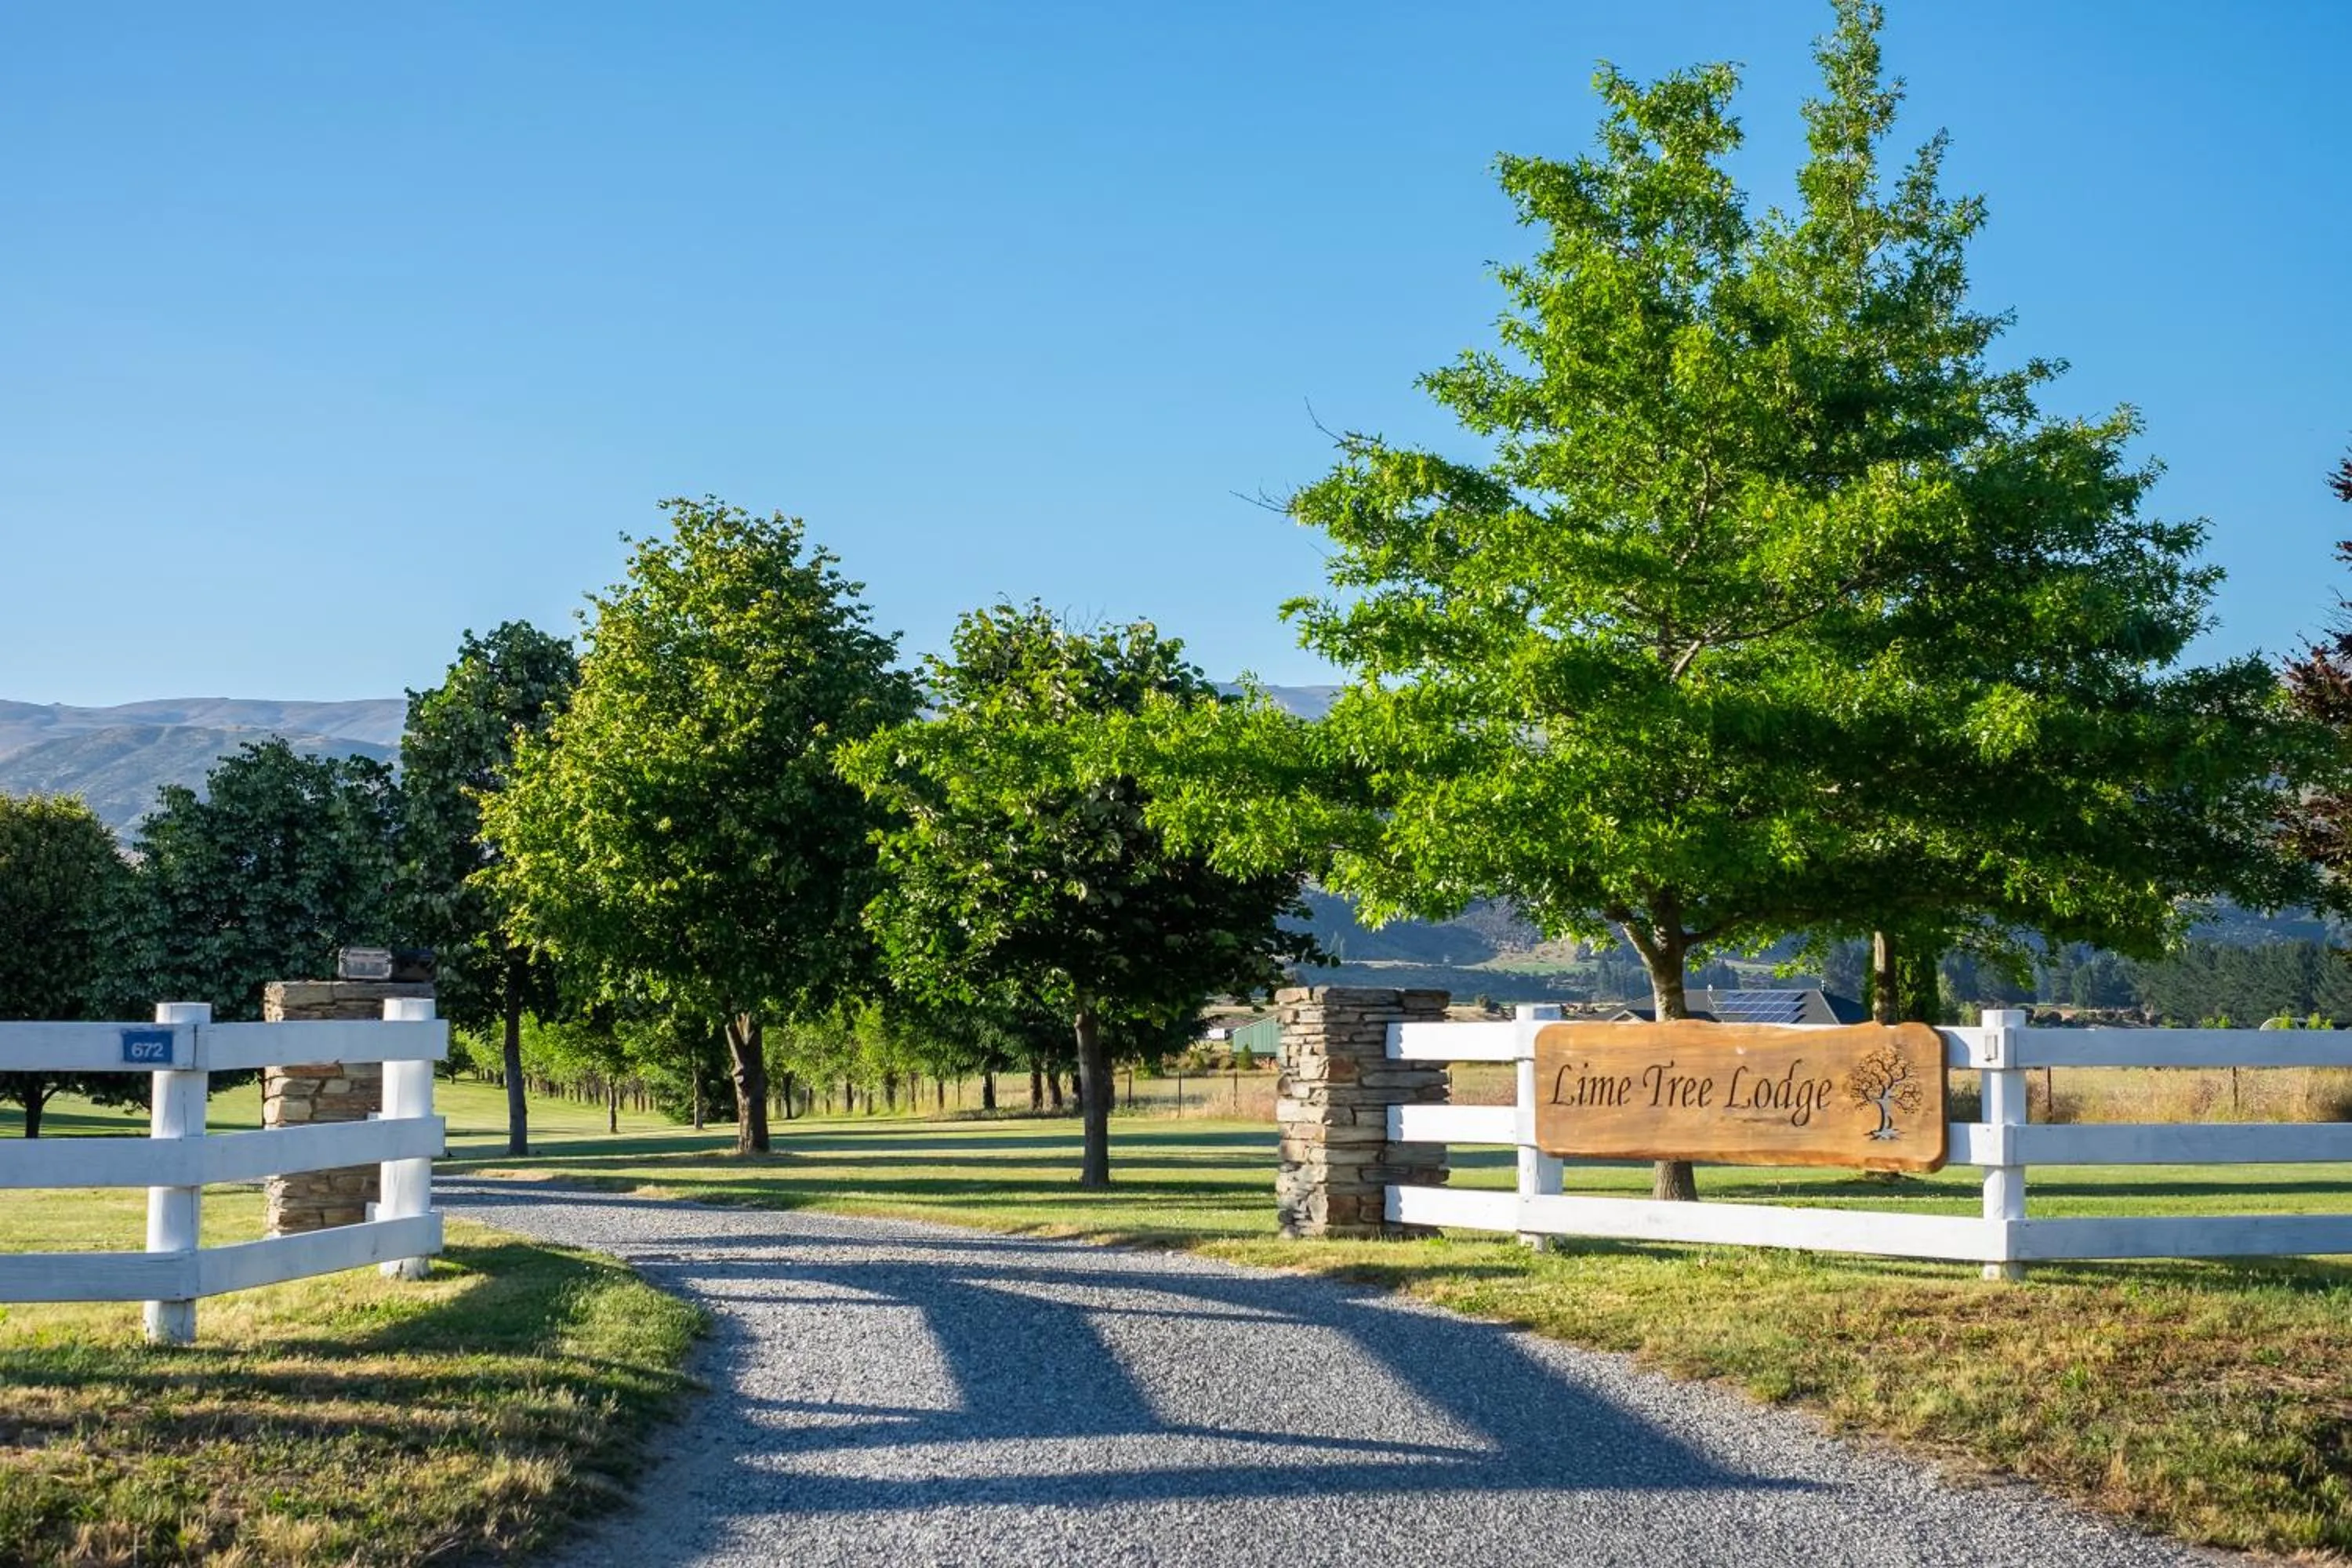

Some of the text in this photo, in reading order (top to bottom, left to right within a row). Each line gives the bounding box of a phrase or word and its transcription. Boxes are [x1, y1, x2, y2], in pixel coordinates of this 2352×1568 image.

[131, 1042, 164, 1058] 672
[1550, 1059, 1832, 1127] Lime Tree Lodge
